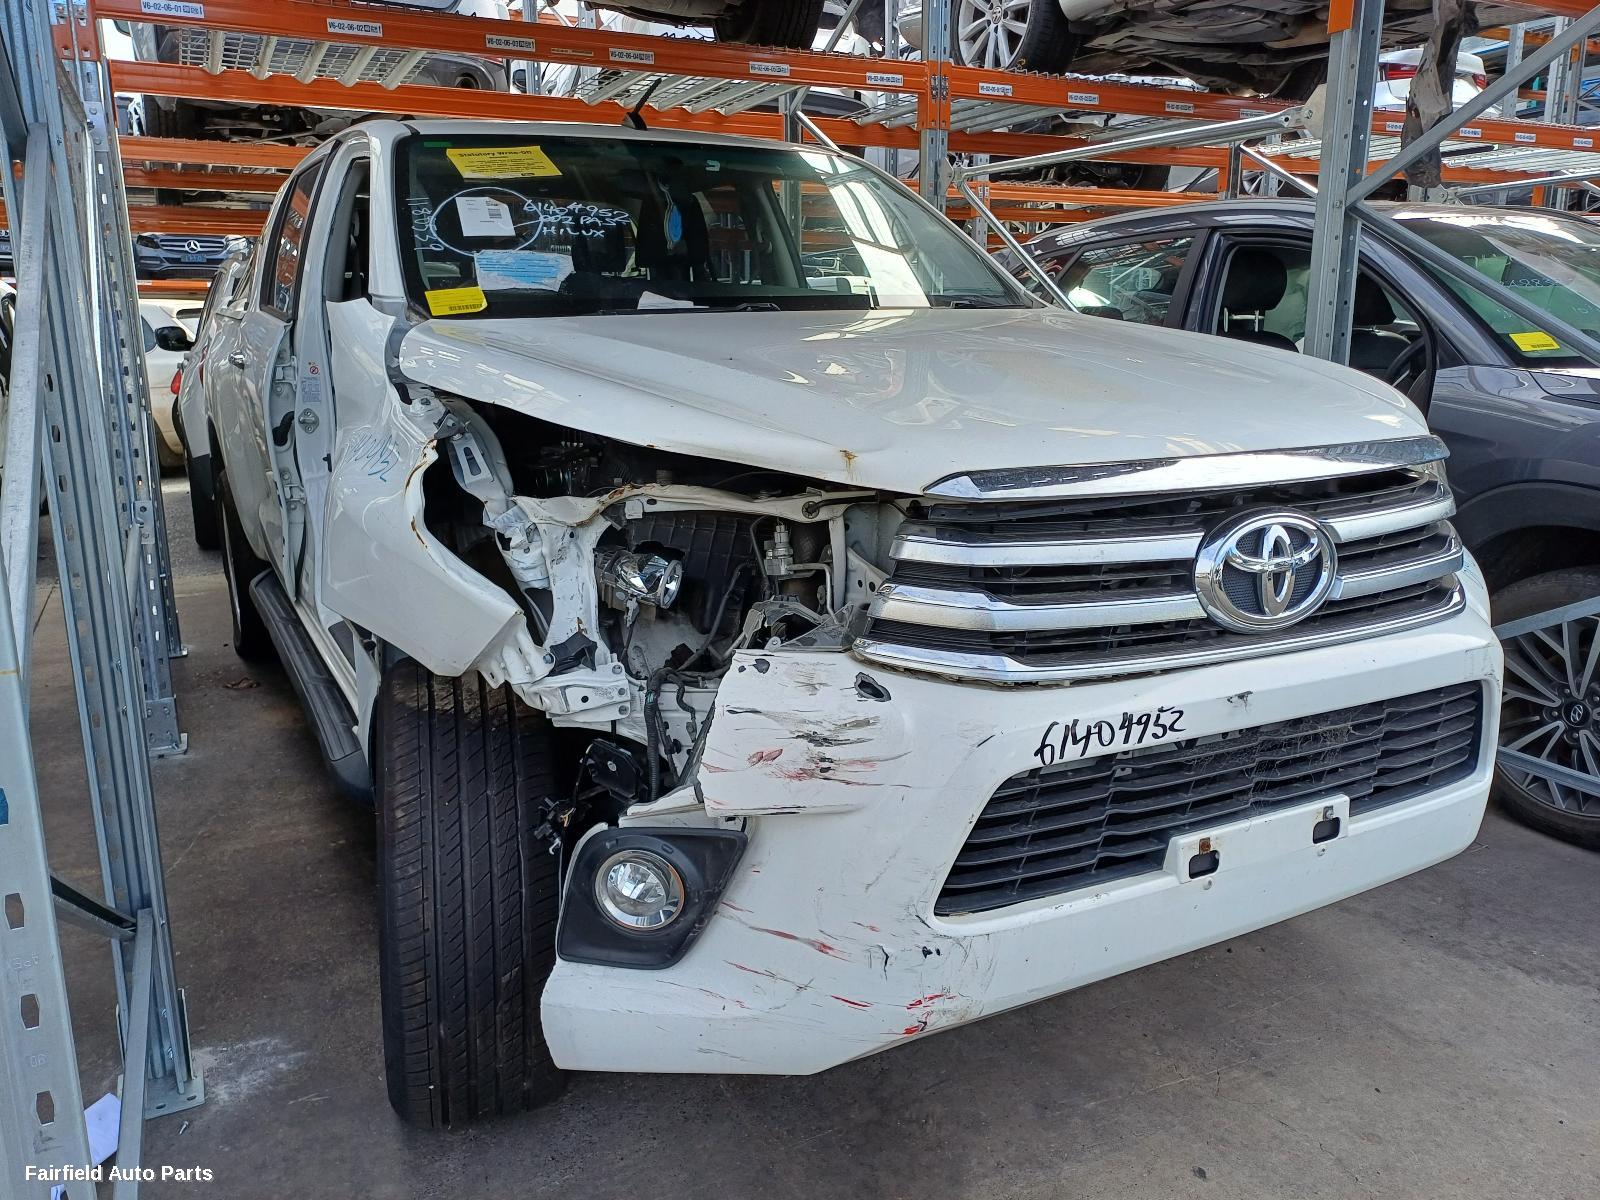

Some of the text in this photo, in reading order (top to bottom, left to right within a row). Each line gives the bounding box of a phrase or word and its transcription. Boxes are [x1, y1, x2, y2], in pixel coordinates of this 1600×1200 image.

[142, 1, 182, 13] V6-02-06-01
[328, 21, 364, 32] V6-02-06-02
[523, 199, 629, 221] 61404952
[1033, 706, 1187, 766] 61404952
